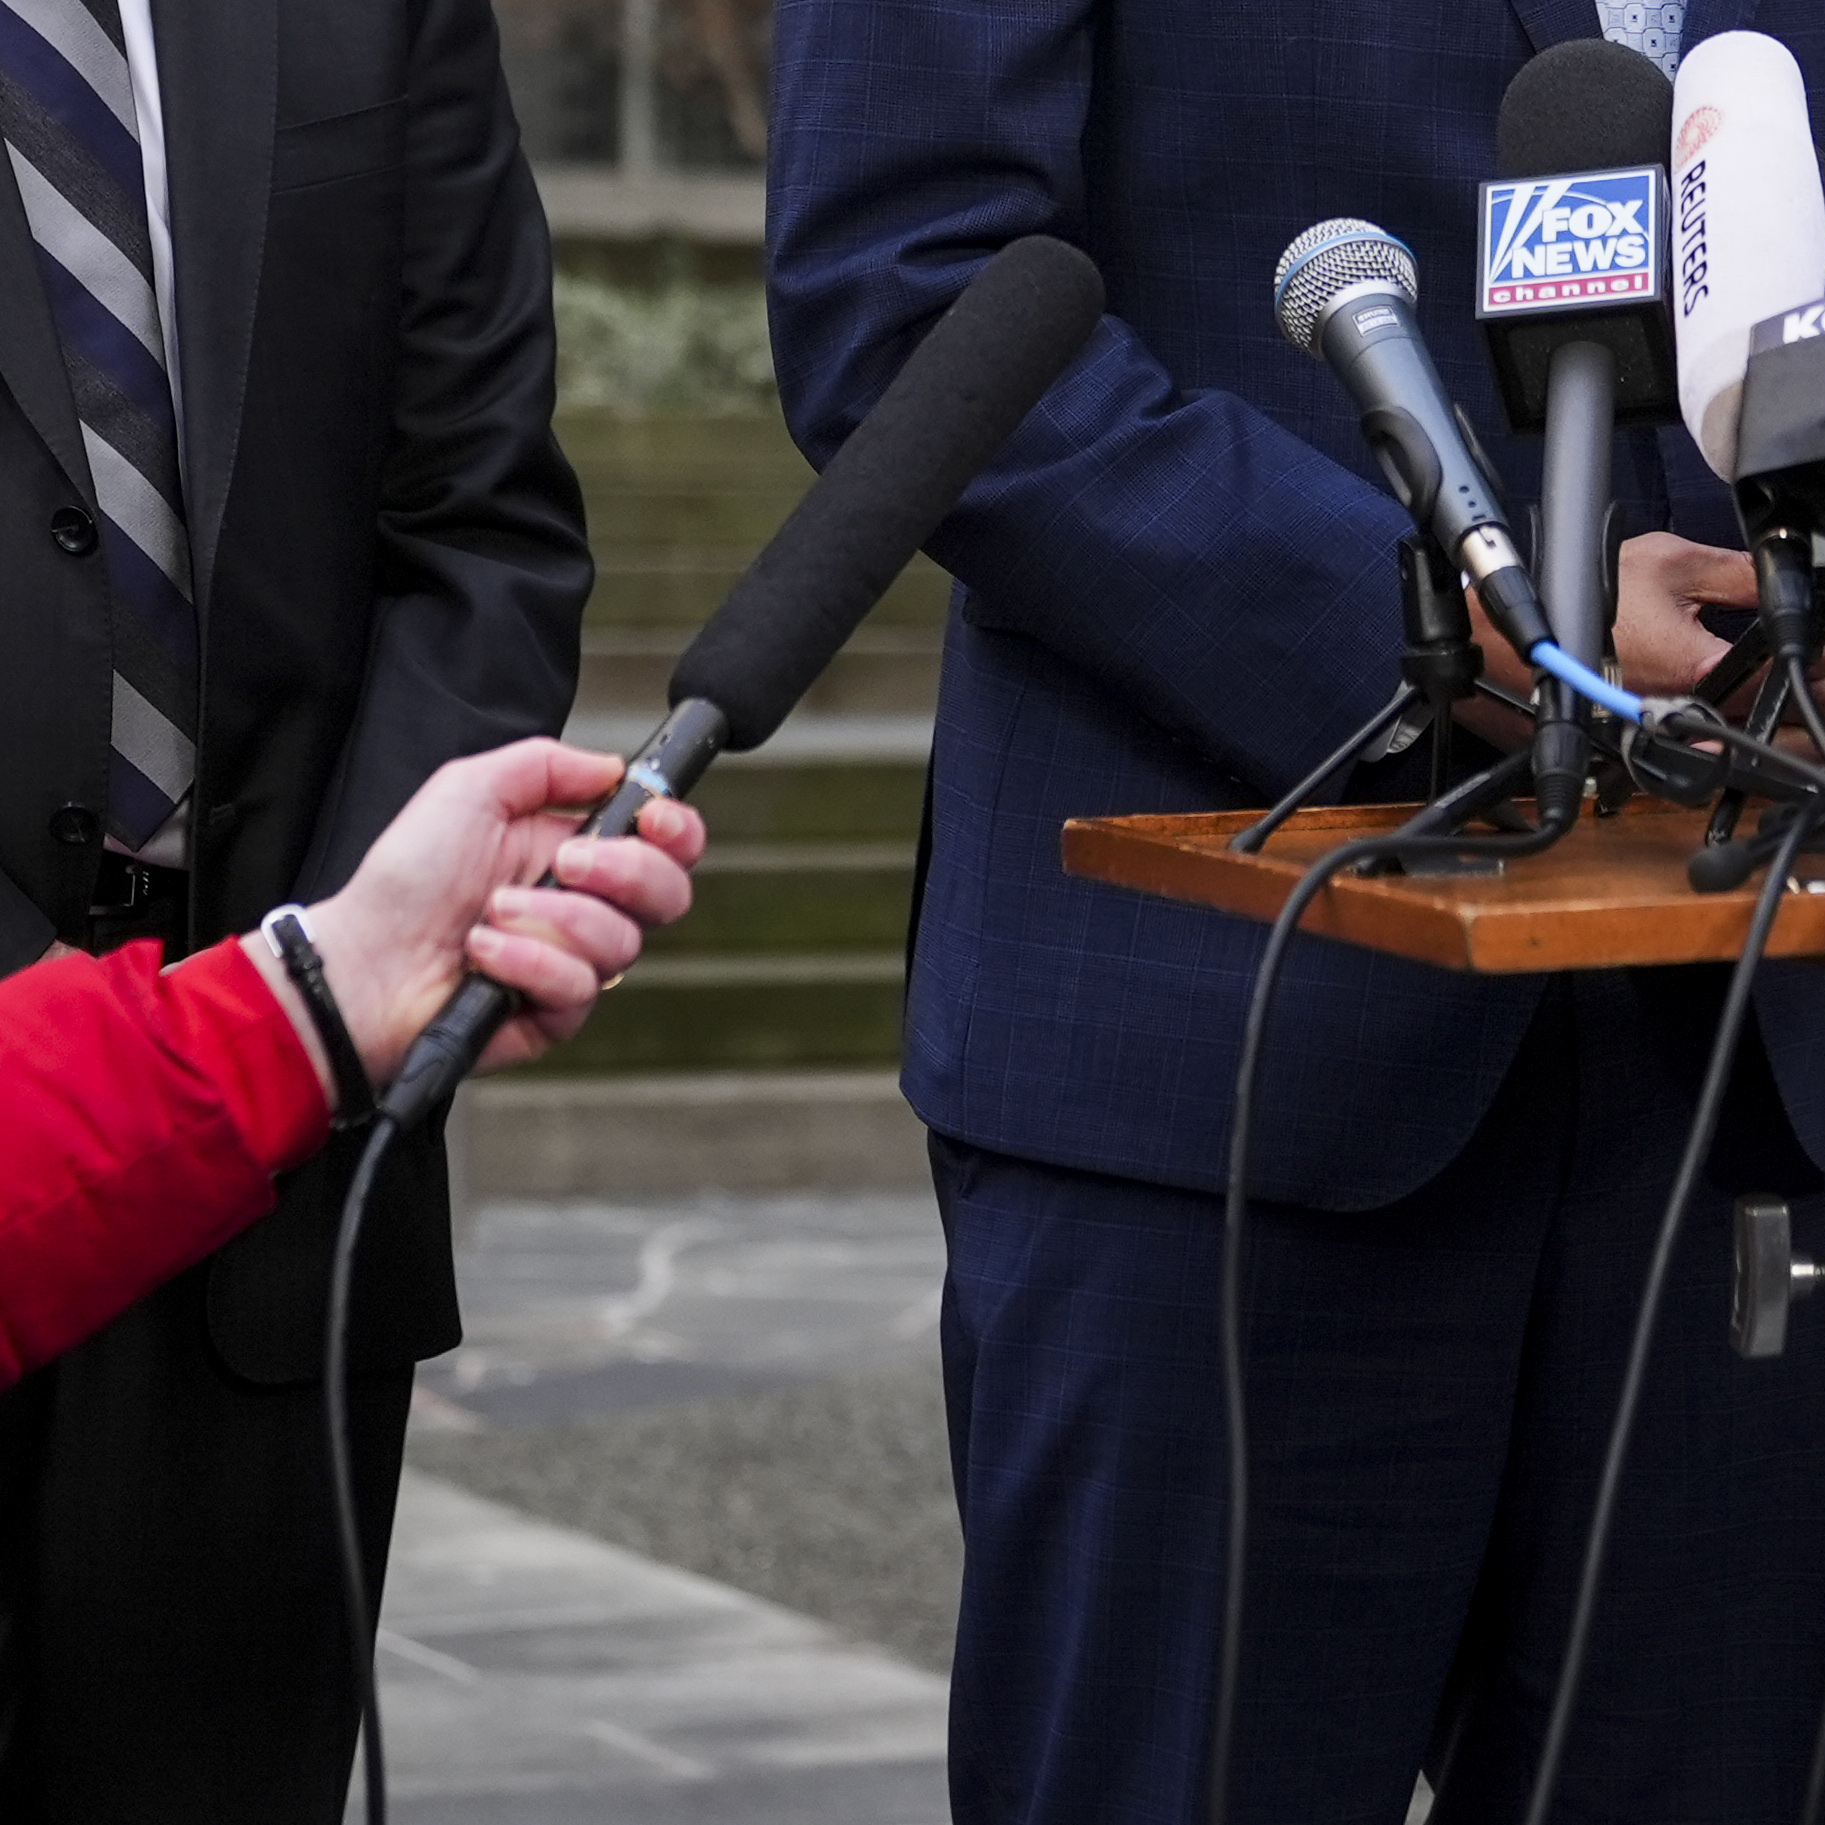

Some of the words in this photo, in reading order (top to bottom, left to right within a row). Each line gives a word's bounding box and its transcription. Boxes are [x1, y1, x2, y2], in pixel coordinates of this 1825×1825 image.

[1542, 199, 1644, 243] FOX
[1680, 159, 1709, 318] REUTERS
[1511, 234, 1646, 279] NEWS
[1492, 274, 1644, 304] channel
